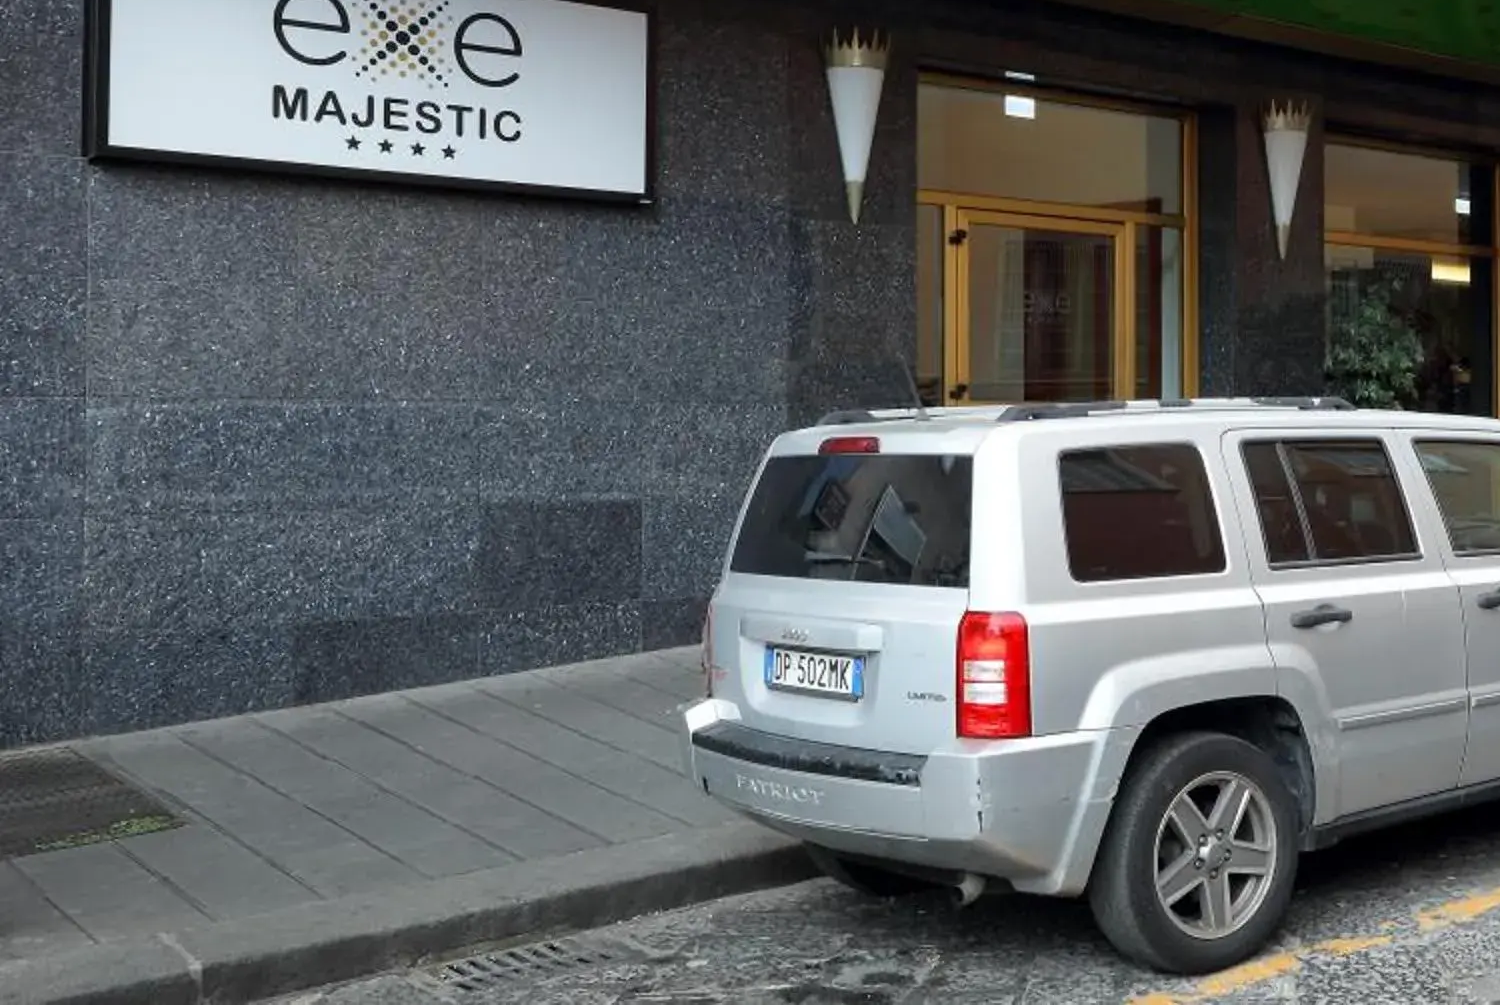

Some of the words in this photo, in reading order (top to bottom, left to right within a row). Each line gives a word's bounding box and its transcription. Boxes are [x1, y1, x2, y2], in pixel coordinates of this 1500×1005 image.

[272, 84, 522, 143] MAJESTIC
[774, 650, 791, 682] DP
[797, 655, 851, 691] 502MK
